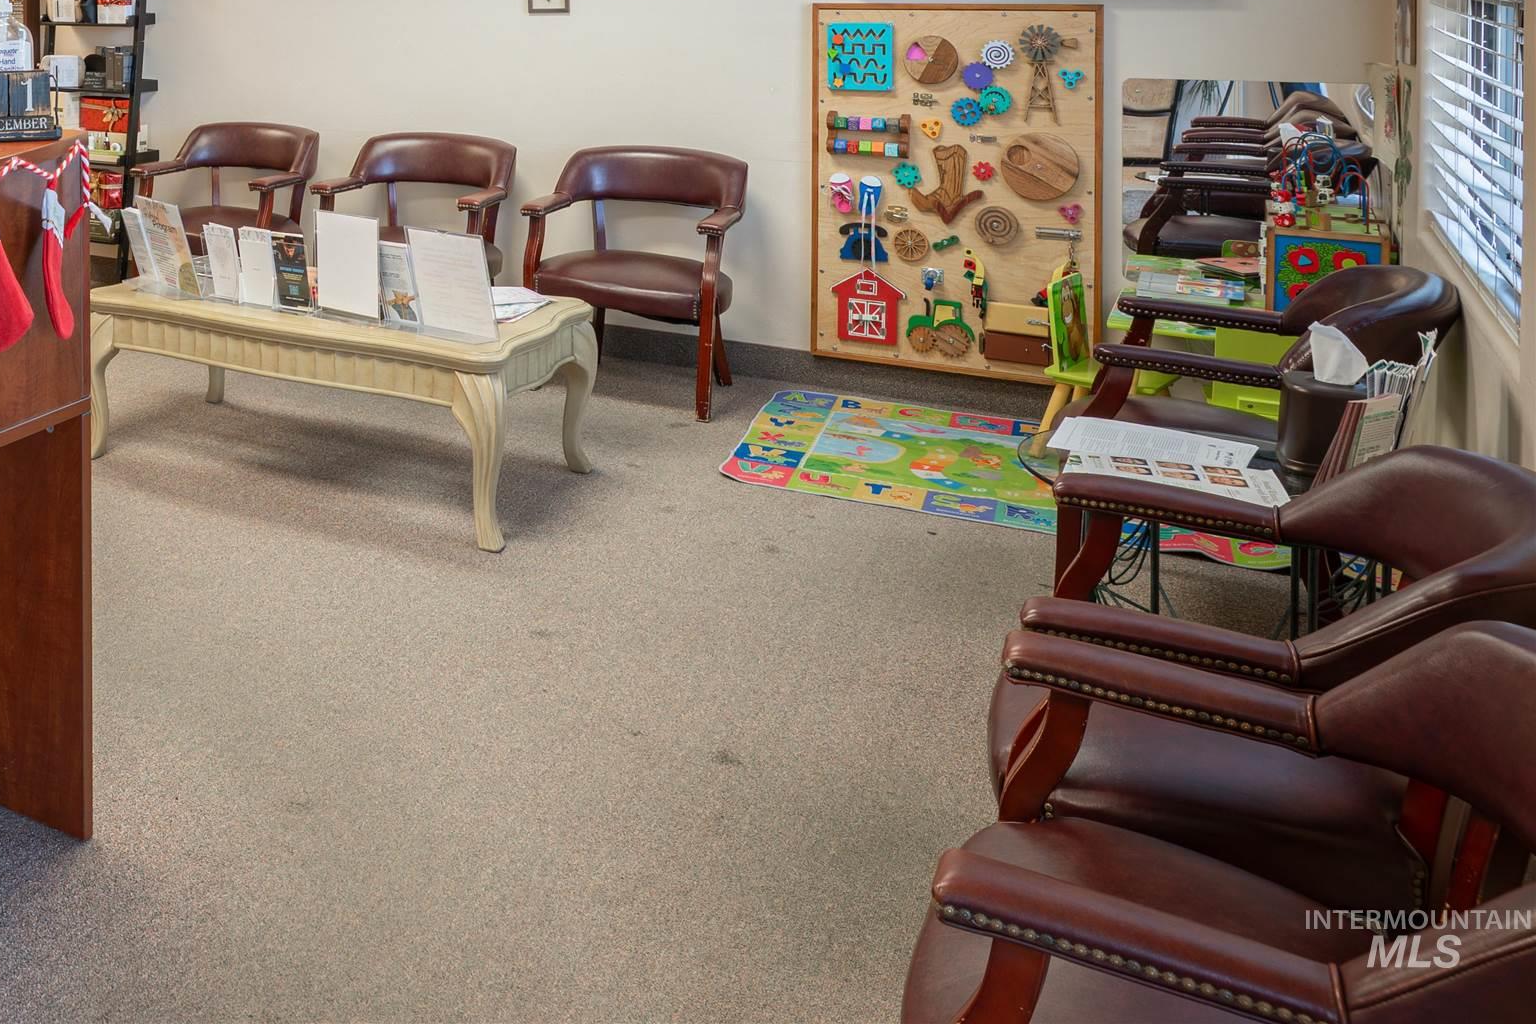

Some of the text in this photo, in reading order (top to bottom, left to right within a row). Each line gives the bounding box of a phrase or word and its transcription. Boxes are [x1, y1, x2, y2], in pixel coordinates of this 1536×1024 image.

[841, 399, 862, 409] B
[758, 432, 784, 441] X
[738, 460, 772, 473] V
[799, 471, 831, 484] U
[864, 483, 892, 495] T
[931, 494, 961, 509] S
